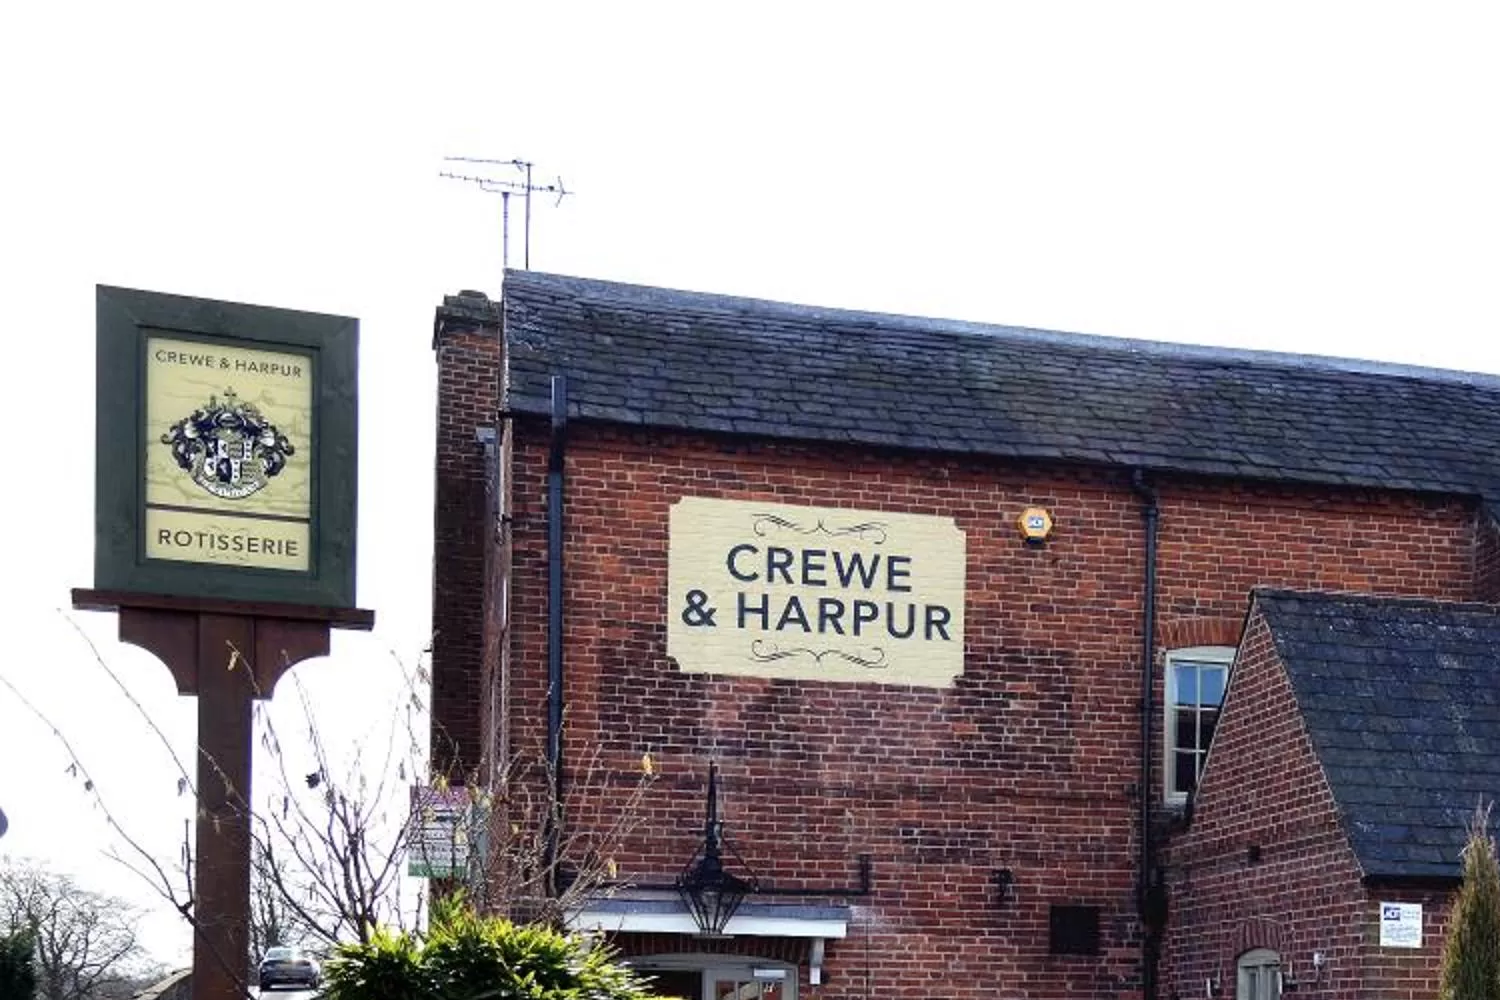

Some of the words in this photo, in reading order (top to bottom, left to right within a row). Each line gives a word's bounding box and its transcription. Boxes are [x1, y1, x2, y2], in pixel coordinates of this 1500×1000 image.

[155, 350, 216, 368] CREWE
[220, 357, 231, 369] &
[235, 359, 302, 377] HARPUR
[157, 529, 300, 557] ROTISSERIE
[726, 543, 912, 592] CREWE
[681, 589, 717, 627] &
[736, 592, 951, 641] HARPUR
